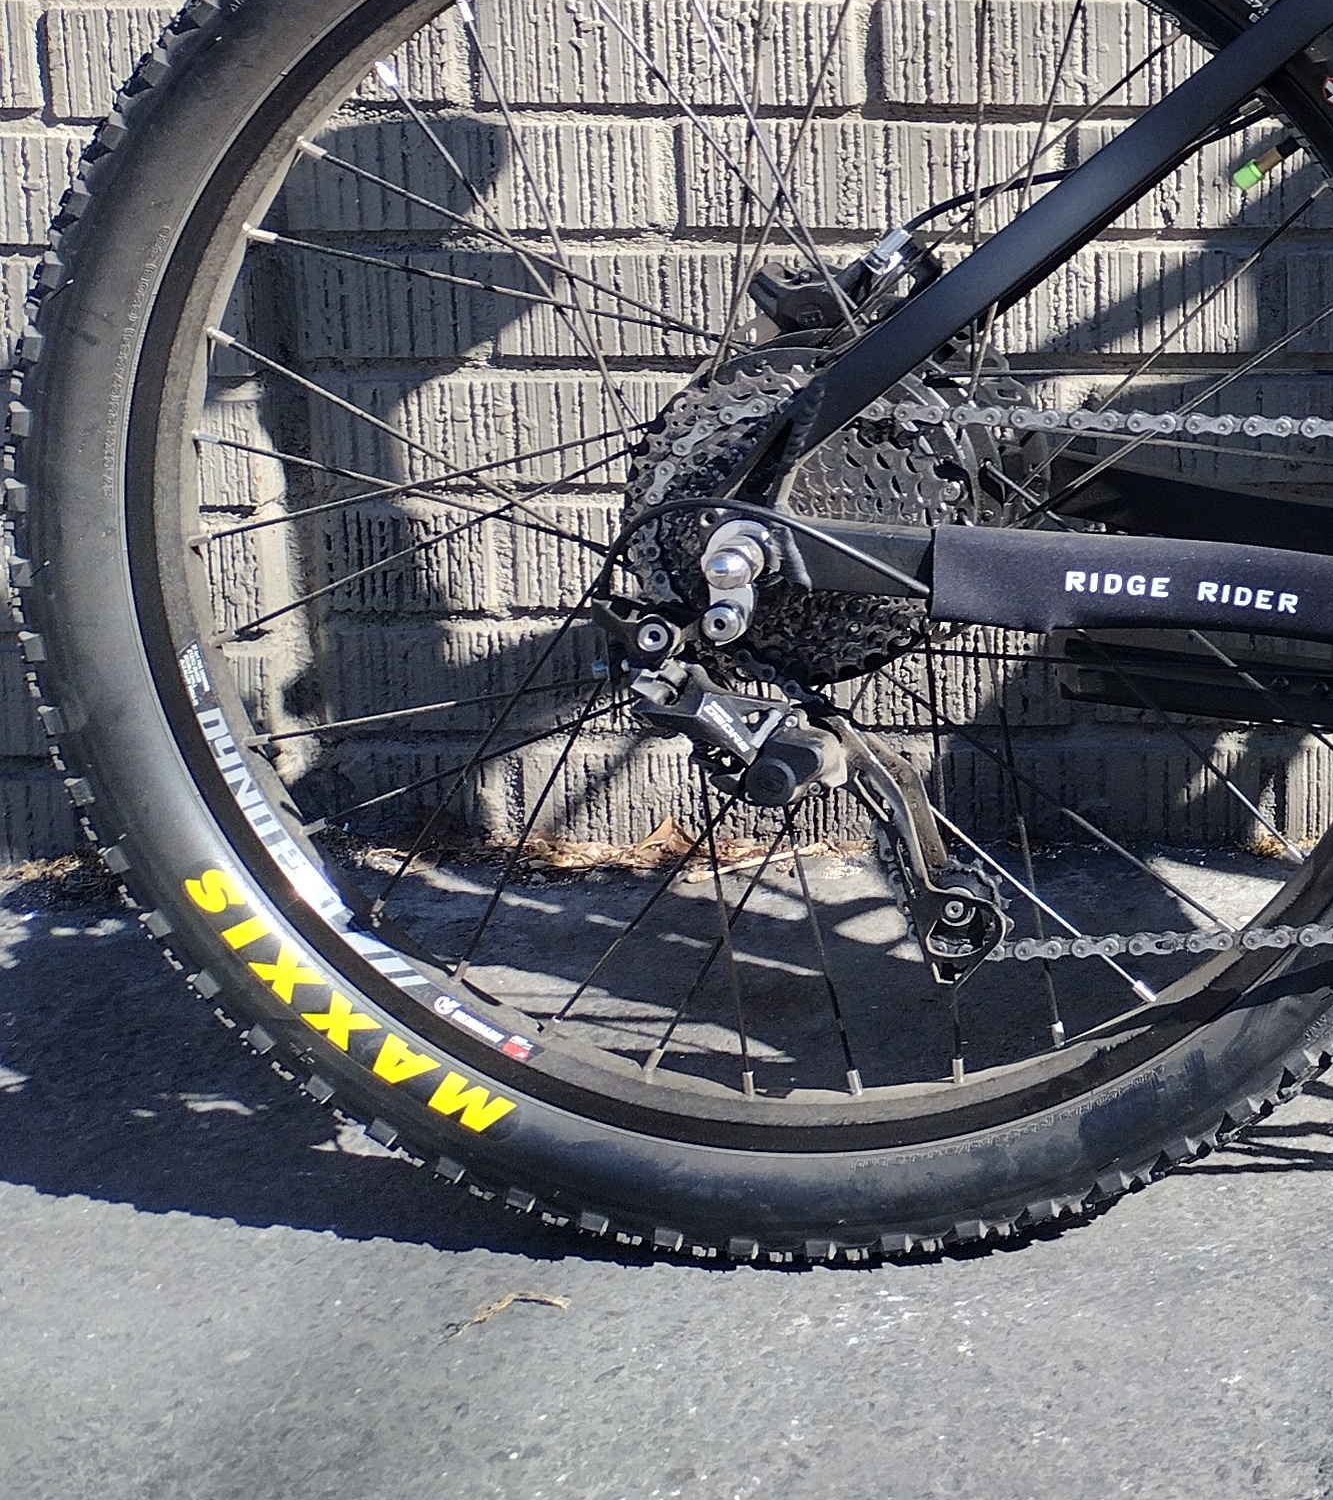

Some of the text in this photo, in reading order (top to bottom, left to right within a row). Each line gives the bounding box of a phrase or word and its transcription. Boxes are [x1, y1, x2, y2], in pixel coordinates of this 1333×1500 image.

[1064, 570, 1300, 615] RIDGE RIDER
[702, 702, 754, 753] DEORE
[184, 868, 517, 1133] MAXXIS
